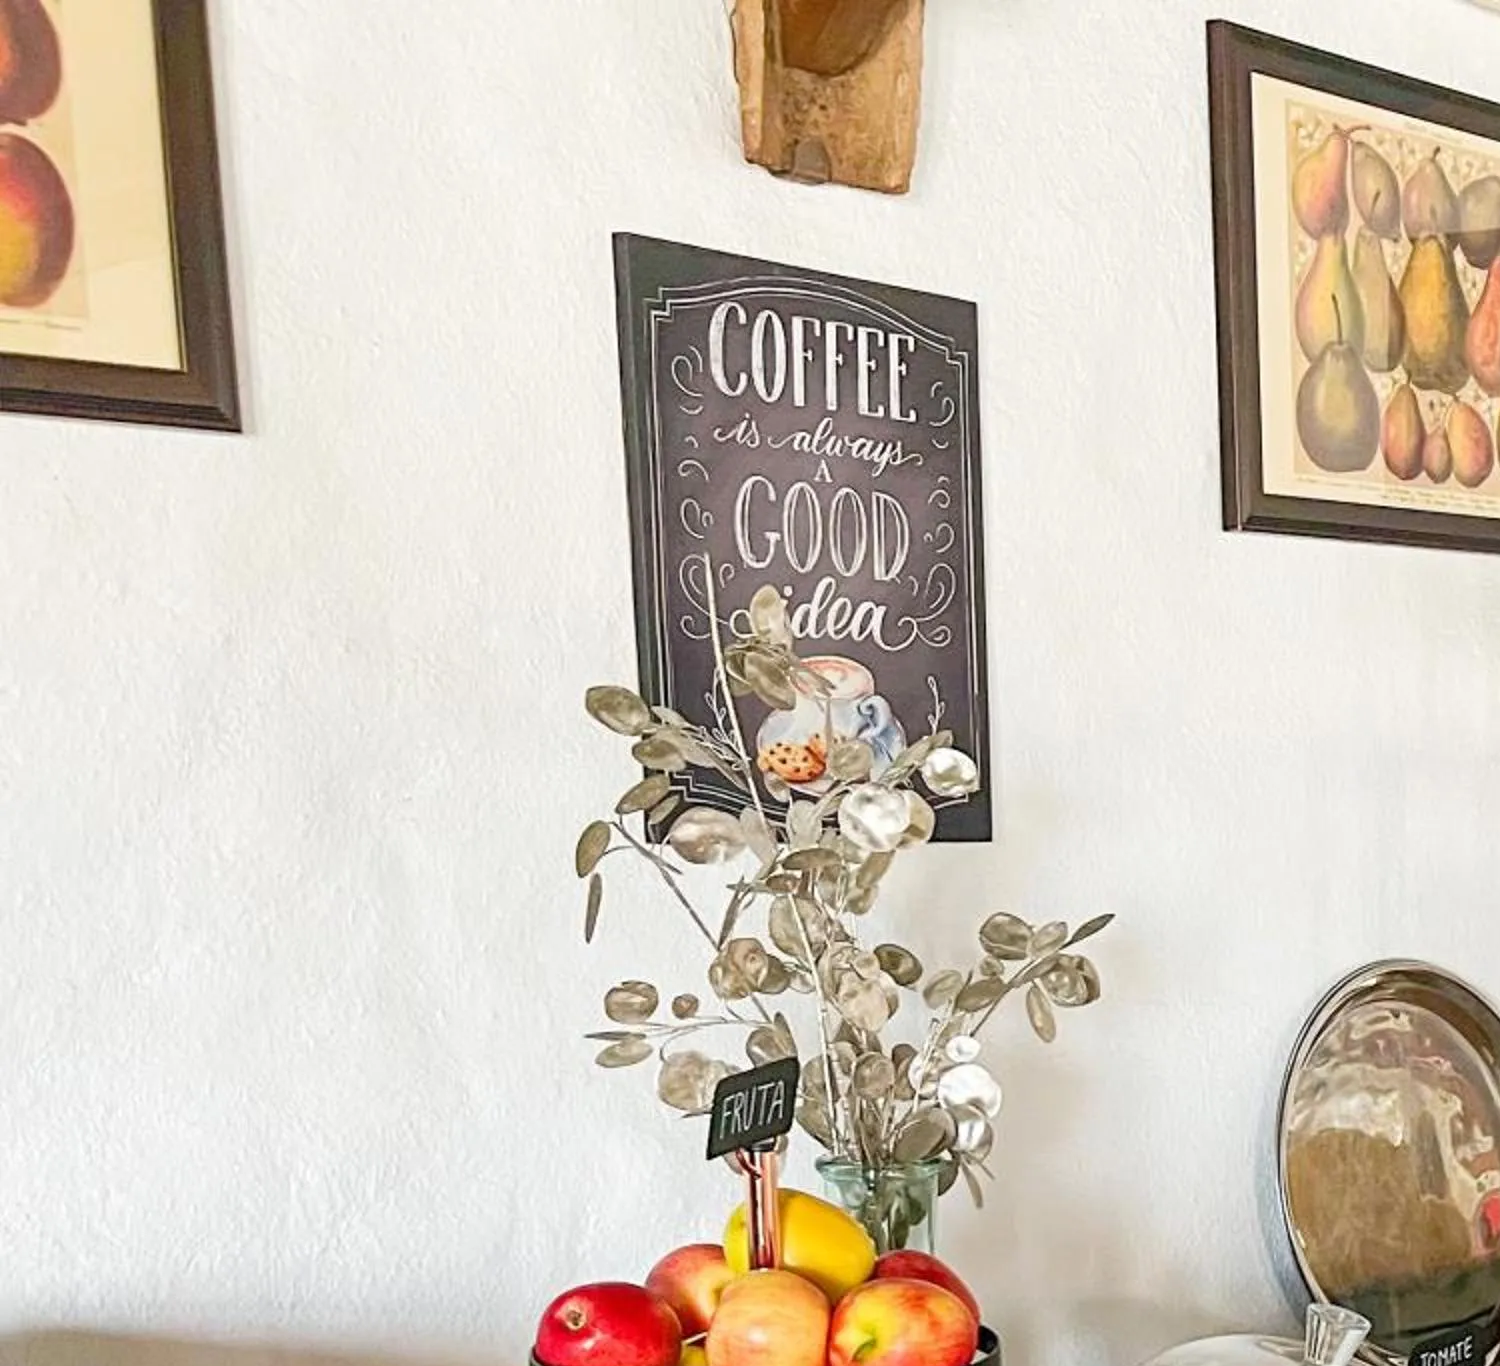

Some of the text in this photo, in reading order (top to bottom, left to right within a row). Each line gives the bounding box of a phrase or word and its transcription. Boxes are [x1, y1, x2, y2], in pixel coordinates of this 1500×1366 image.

[708, 301, 918, 423] COFFEE
[714, 414, 923, 477] is always
[813, 460, 833, 484] A
[735, 476, 912, 581] GOOD
[720, 1080, 784, 1140] FRUTA
